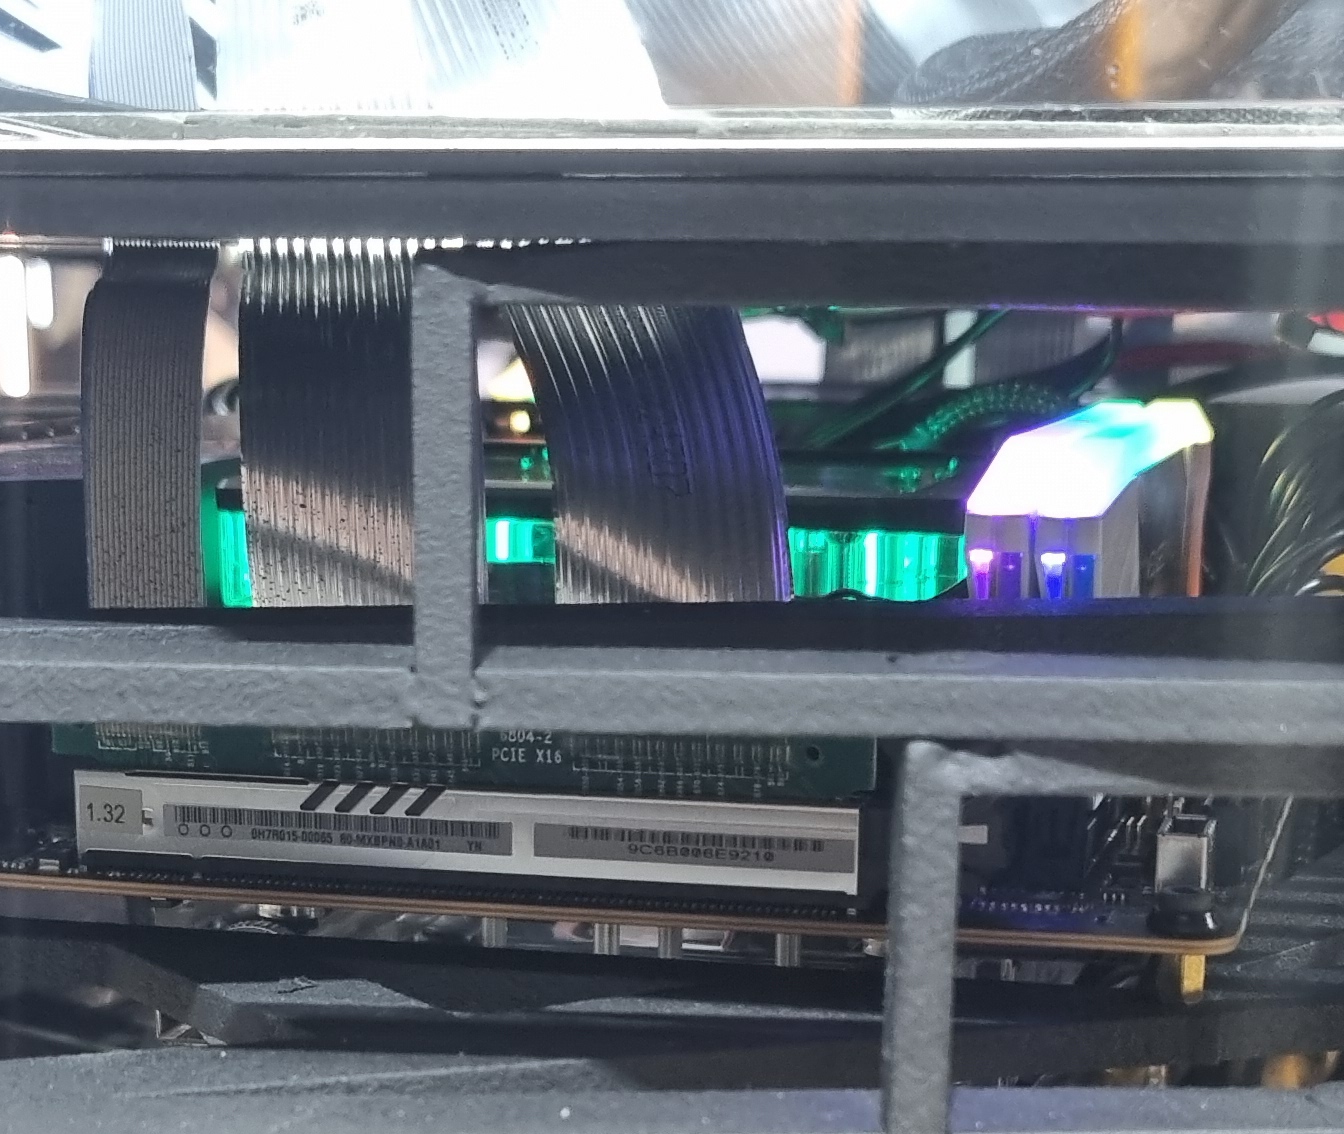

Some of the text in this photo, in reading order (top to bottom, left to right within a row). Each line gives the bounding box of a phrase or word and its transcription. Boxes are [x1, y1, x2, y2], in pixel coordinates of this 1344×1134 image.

[492, 747, 562, 764] PCIE X16
[86, 802, 126, 824] 1.32
